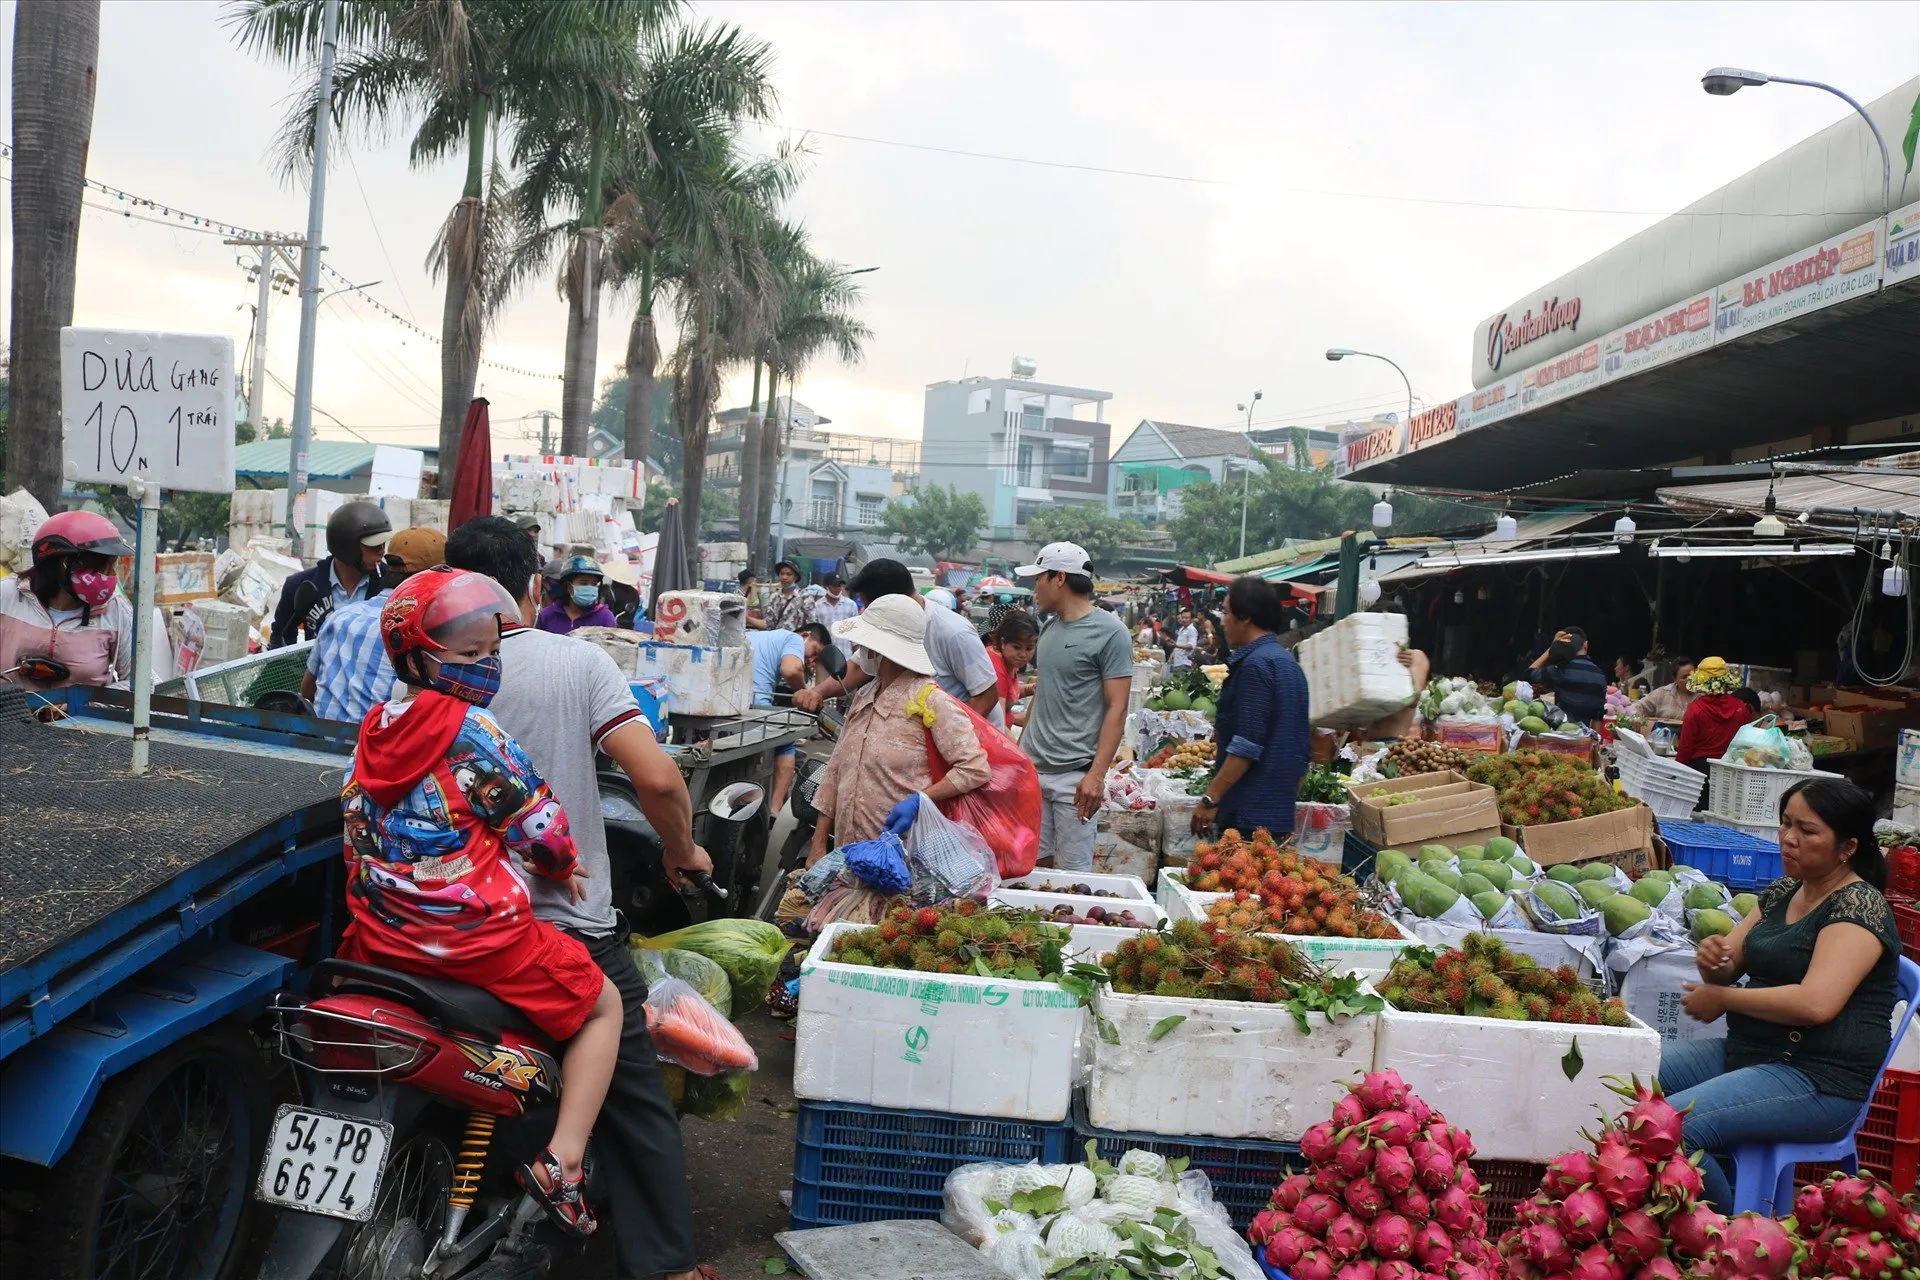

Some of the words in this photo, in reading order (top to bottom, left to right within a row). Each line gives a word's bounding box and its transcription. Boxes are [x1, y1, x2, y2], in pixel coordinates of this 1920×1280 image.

[1742, 277, 1766, 308] BA
[1768, 246, 1839, 298] NGHIỆP
[171, 360, 219, 391] GANG
[1434, 400, 1457, 436] 236
[1372, 427, 1393, 458] 236
[273, 1157, 357, 1211] 6674
